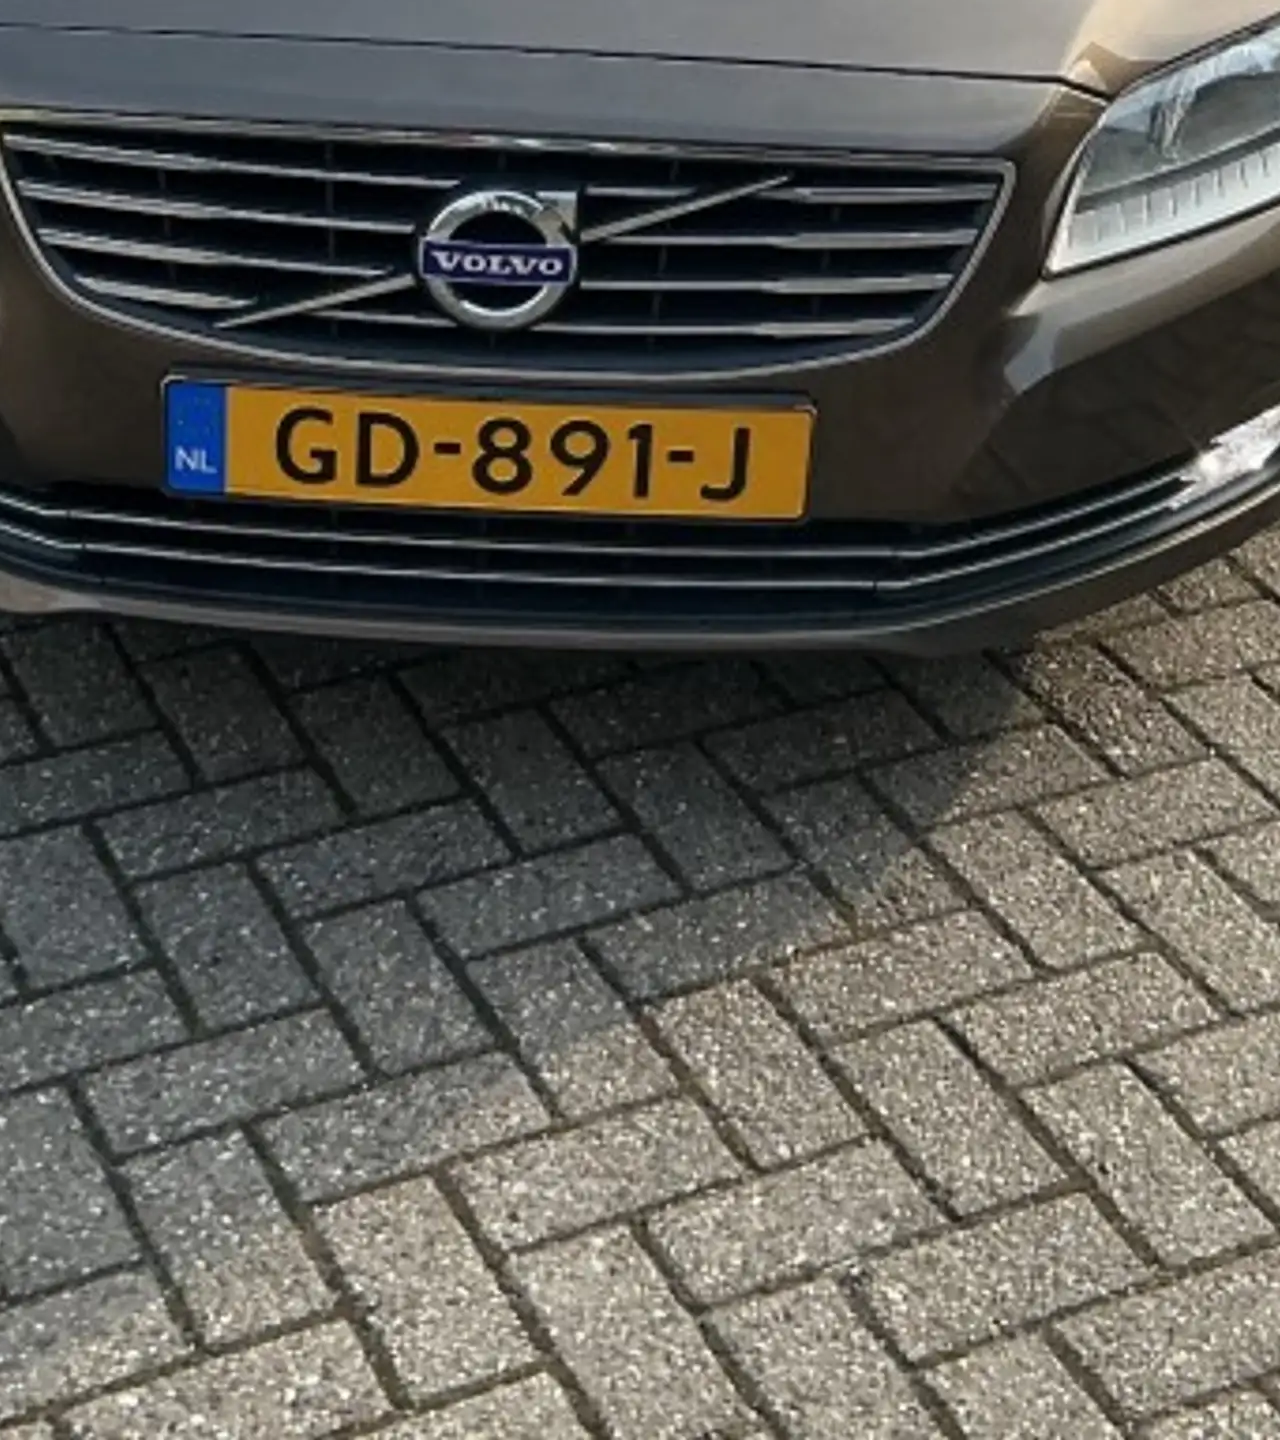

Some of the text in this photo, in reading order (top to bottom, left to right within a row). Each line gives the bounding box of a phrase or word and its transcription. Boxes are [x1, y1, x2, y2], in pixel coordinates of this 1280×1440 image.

[431, 250, 563, 276] VOLVO
[174, 405, 751, 502] NL GD-891-J
